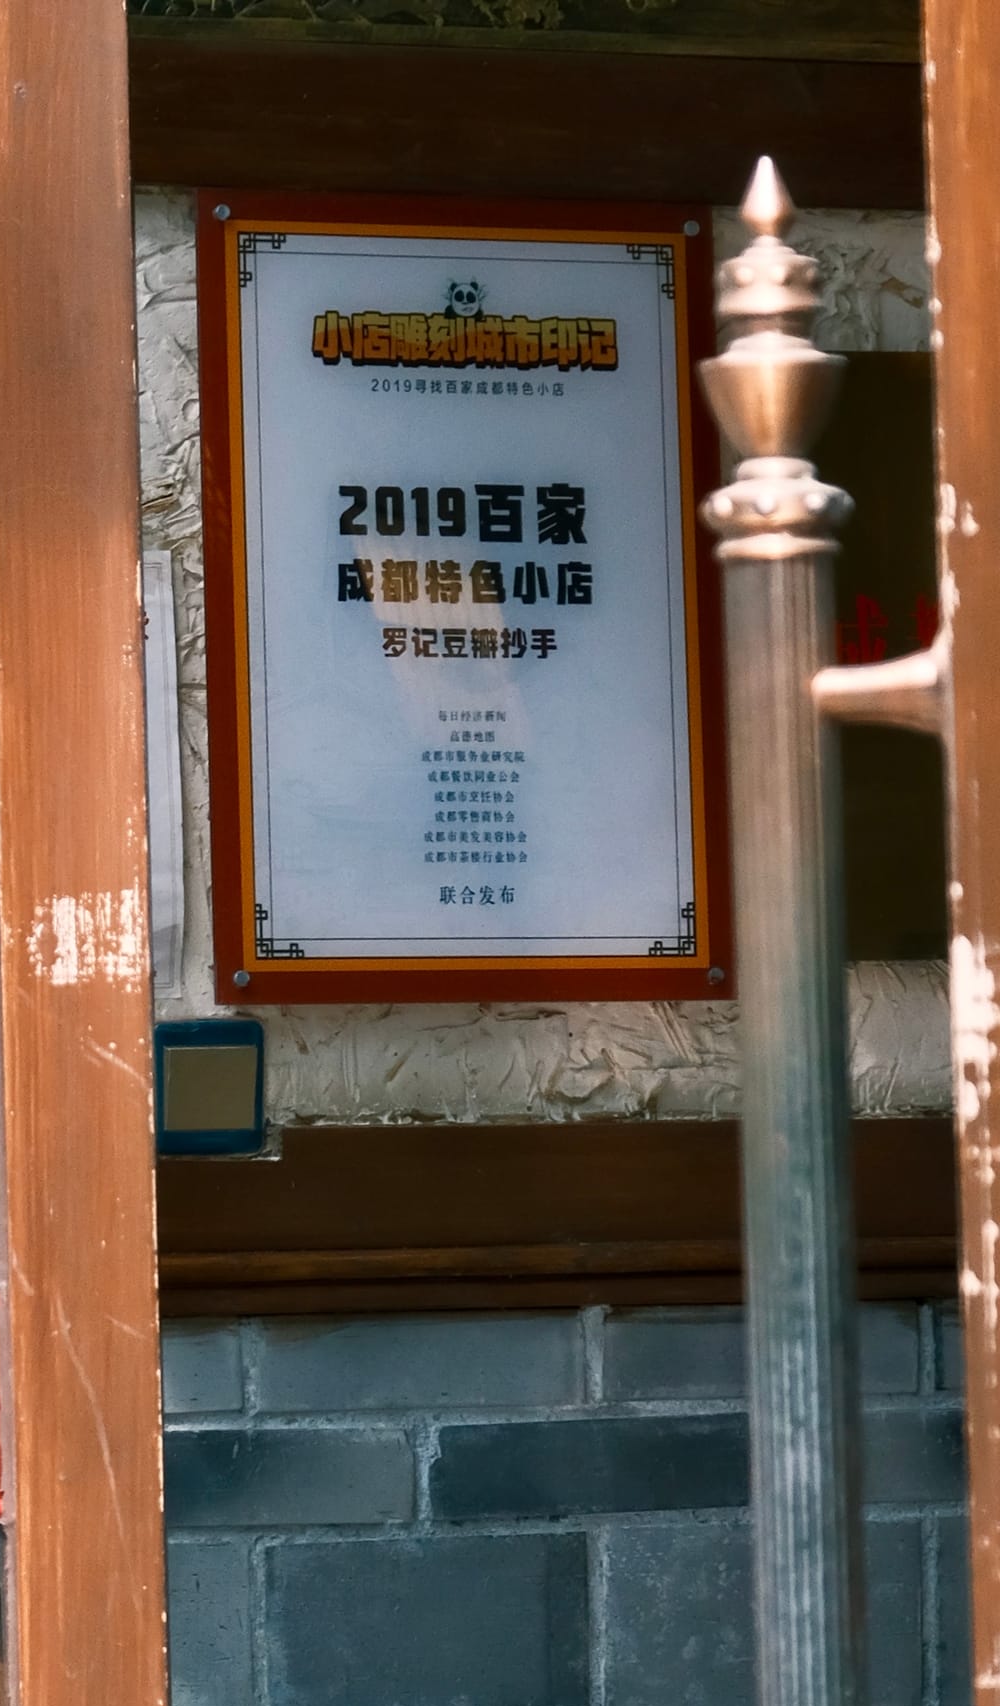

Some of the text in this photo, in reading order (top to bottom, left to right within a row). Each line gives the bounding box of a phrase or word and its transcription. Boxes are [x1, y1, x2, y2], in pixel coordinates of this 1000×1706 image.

[312, 310, 618, 371] 小店雕刻城市印记
[370, 377, 565, 397] 2019寻找百家成都特色小店
[338, 482, 588, 545] 2019百家
[337, 558, 594, 605] 成都特色小店
[382, 627, 558, 659] 罗记豆瓣抄手
[438, 710, 507, 722] 每日经济新闻
[450, 731, 496, 743] 高德地图
[421, 751, 526, 763] 成都市服务业研究院
[427, 771, 520, 783] 成都餐饮同业公会
[434, 791, 515, 804] 成都市烹饪协会
[435, 811, 516, 823] 成都零售商协会
[424, 831, 528, 843] 成都市美发美容协会
[439, 885, 516, 905] 联合发布
